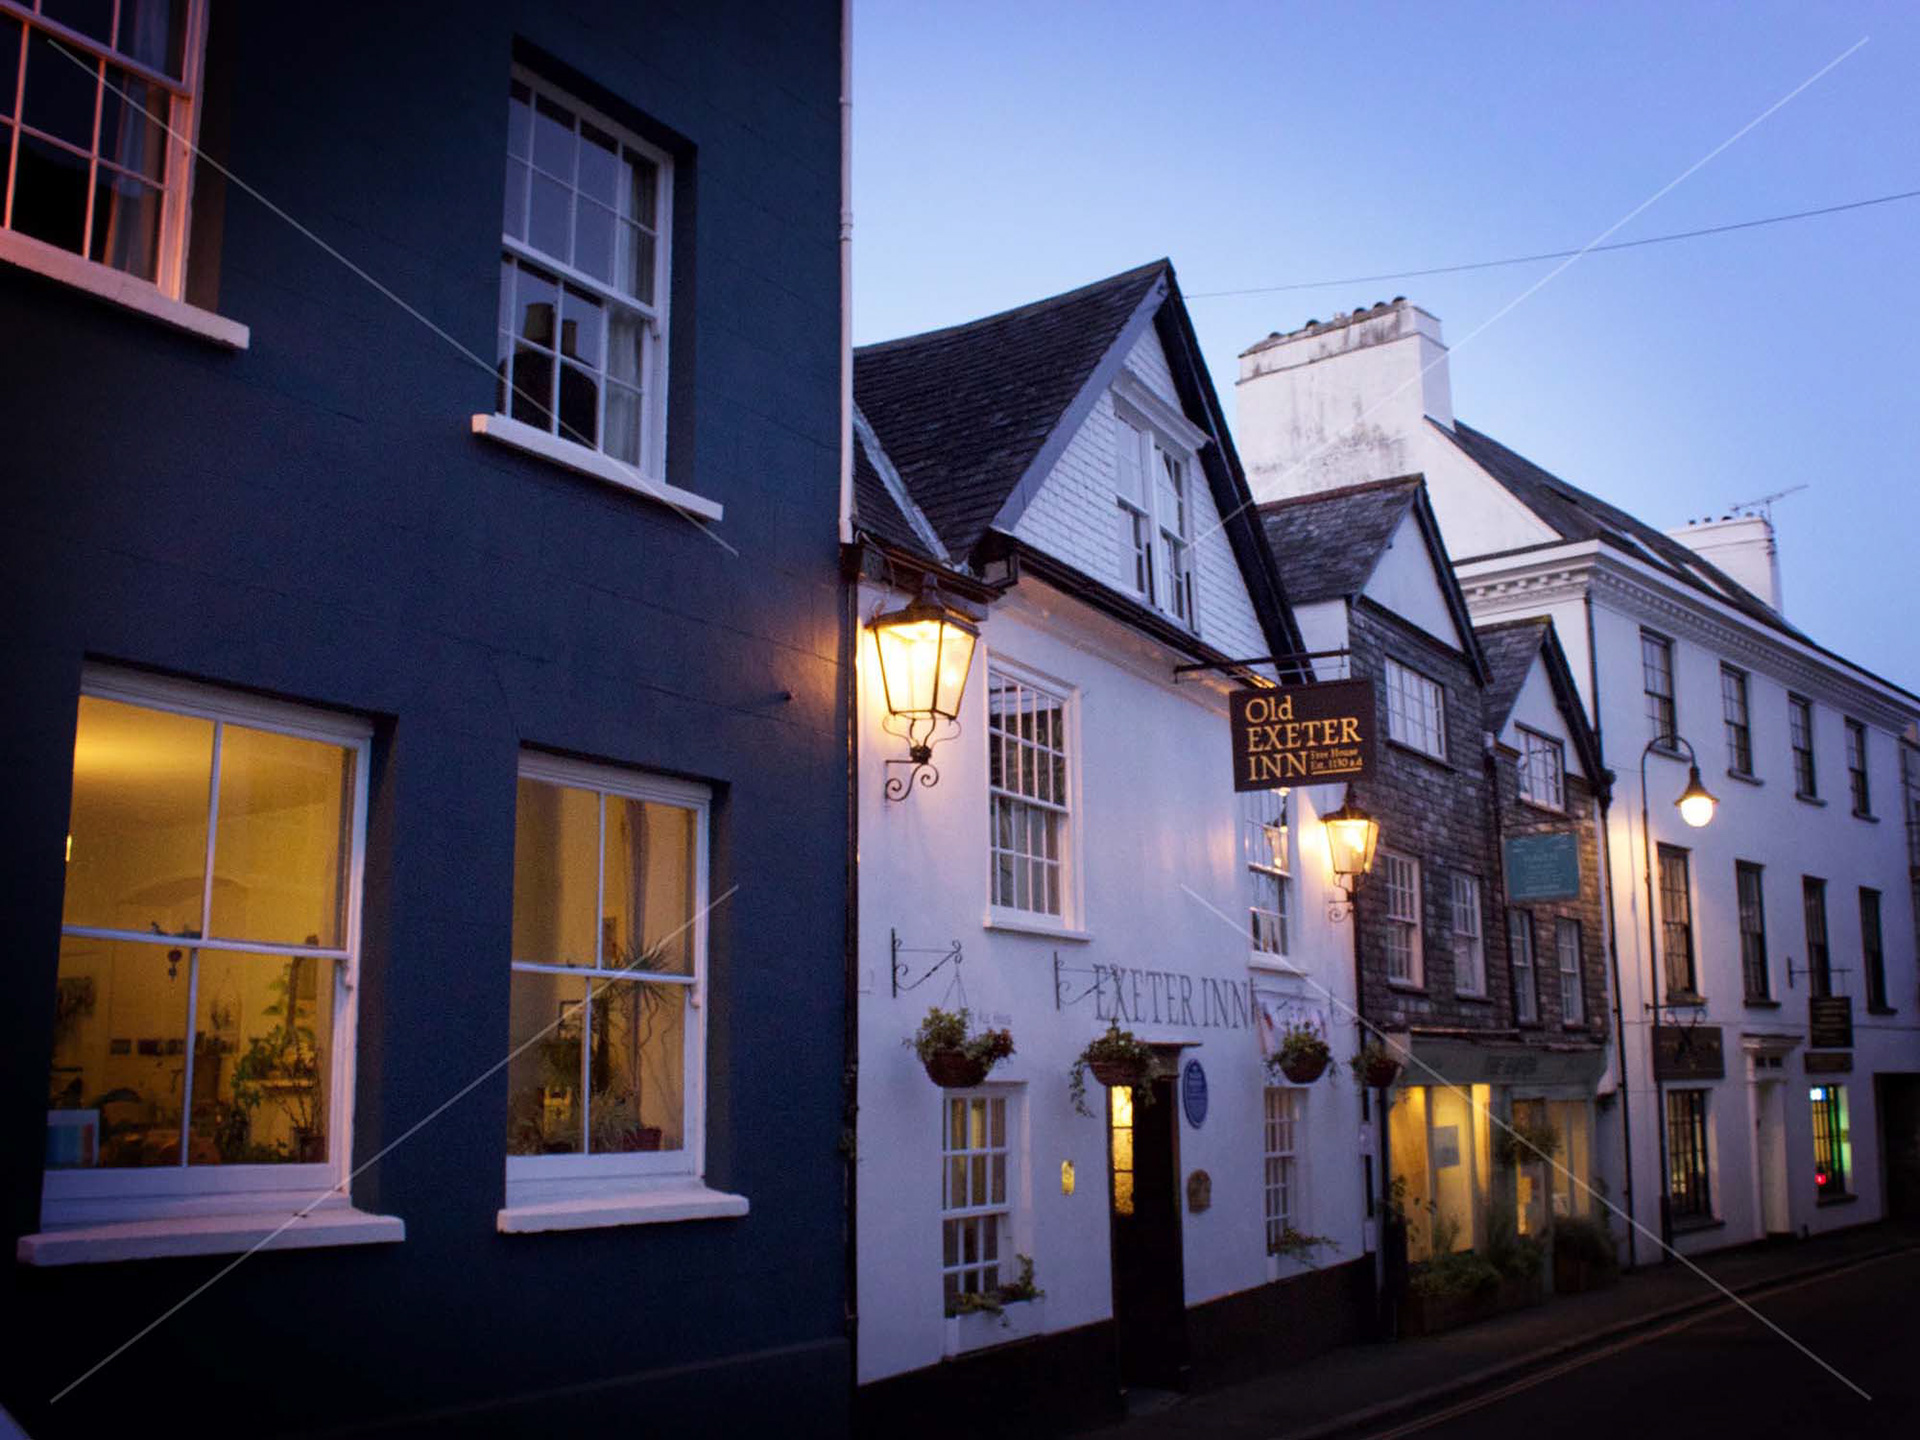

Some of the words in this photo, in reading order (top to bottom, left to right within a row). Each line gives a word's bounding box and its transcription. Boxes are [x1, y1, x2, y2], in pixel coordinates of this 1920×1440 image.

[1245, 695, 1294, 723] Old
[1246, 717, 1363, 752] EXETER
[1248, 751, 1308, 781] INN
[1092, 963, 1197, 1027] EXETER
[1200, 976, 1250, 1030] INN
